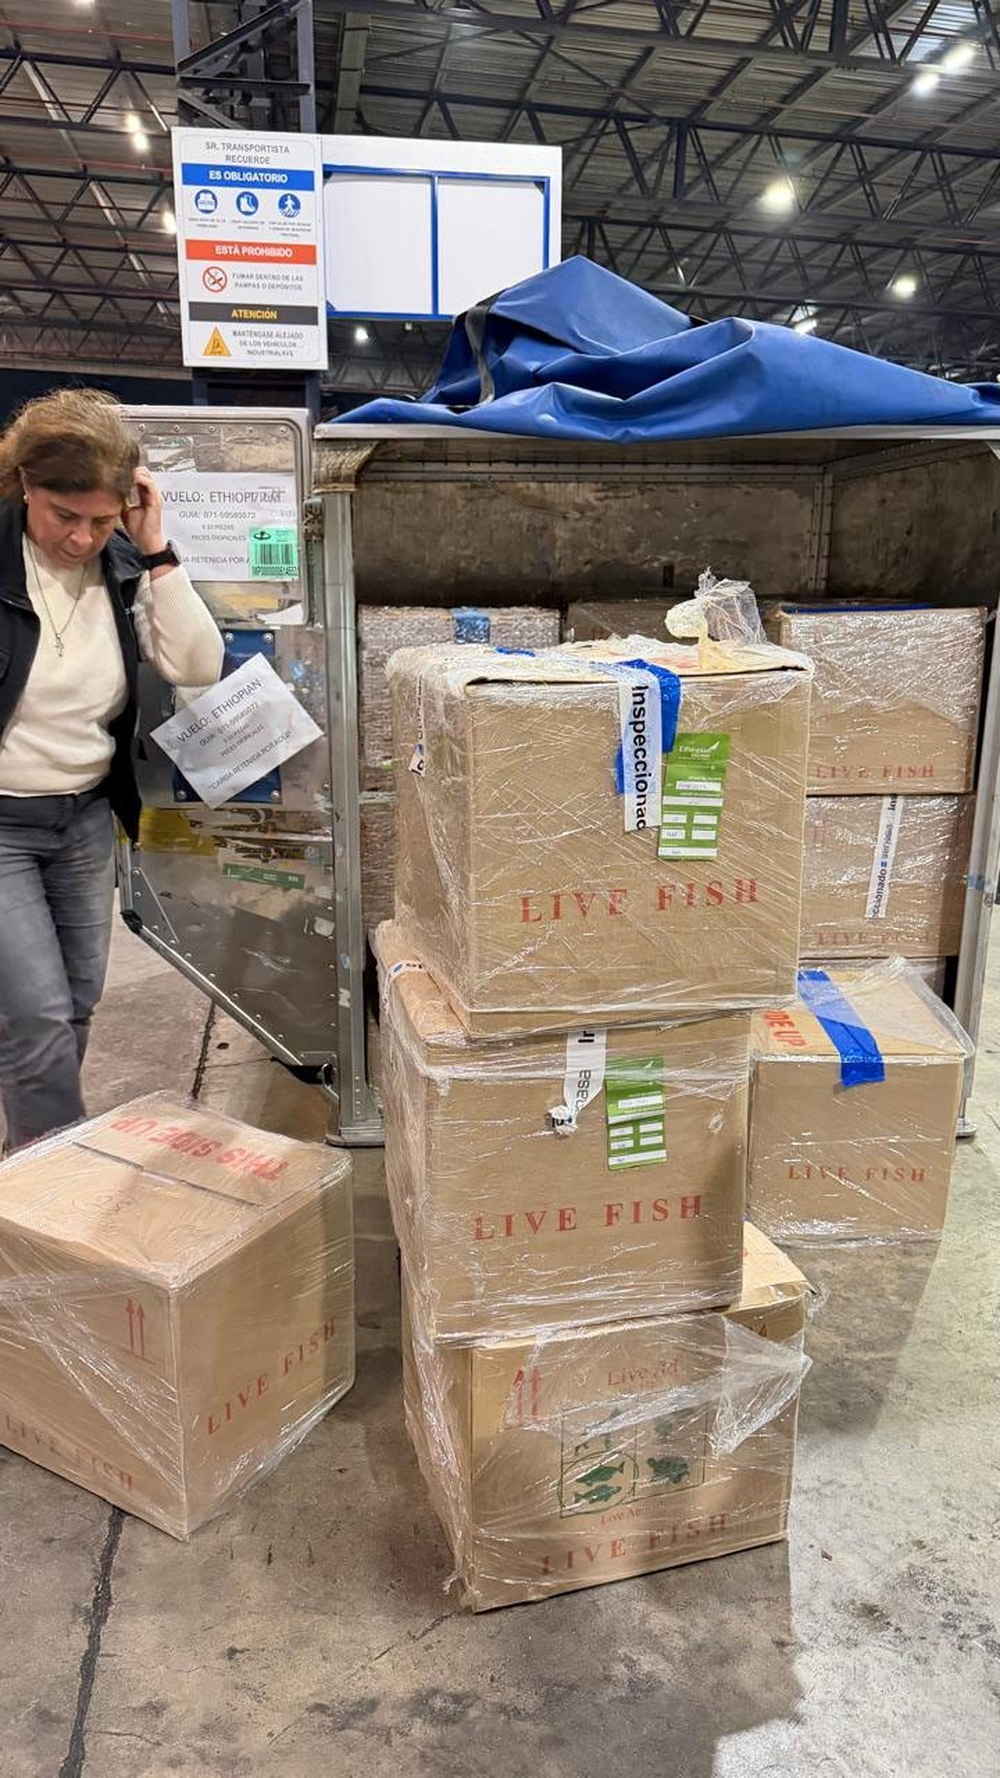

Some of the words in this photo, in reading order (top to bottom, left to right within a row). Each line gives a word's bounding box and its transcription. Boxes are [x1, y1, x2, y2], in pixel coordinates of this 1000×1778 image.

[221, 142, 290, 154] TRANSPORTISTA
[225, 154, 271, 164] RECUERDE
[208, 170, 222, 180] ES
[223, 171, 288, 184] OBLIGATORIO
[215, 244, 240, 256] ESTÁ
[241, 247, 293, 258] PROHIBIDO
[232, 272, 254, 280] FUMAR
[255, 273, 281, 281] DENTRO
[231, 307, 278, 319] ATENCIÓN
[275, 331, 304, 340] ALEJADO
[162, 490, 205, 504] VUELO:
[211, 534, 246, 542] TROPICALES
[191, 556, 227, 565] RETENIDA
[176, 716, 213, 743] VUELO:
[211, 678, 262, 720] ETHIOPIAN
[816, 766, 869, 779] LIVE
[882, 765, 934, 778] FISH
[519, 888, 628, 923] LIVE
[657, 877, 758, 911] FISH
[773, 1030, 807, 1047] UP
[110, 1115, 158, 1138] UP
[149, 1126, 222, 1158] SIDE
[216, 1145, 290, 1182] THIS
[788, 1165, 847, 1180] LIVE
[866, 1167, 926, 1182] FISH
[473, 1206, 578, 1241] LIVE
[603, 1195, 702, 1227] FISH
[206, 1374, 270, 1437] LIVE
[283, 1316, 339, 1375] FISH
[539, 1539, 627, 1577] LIVE
[650, 1512, 728, 1549] FISH
